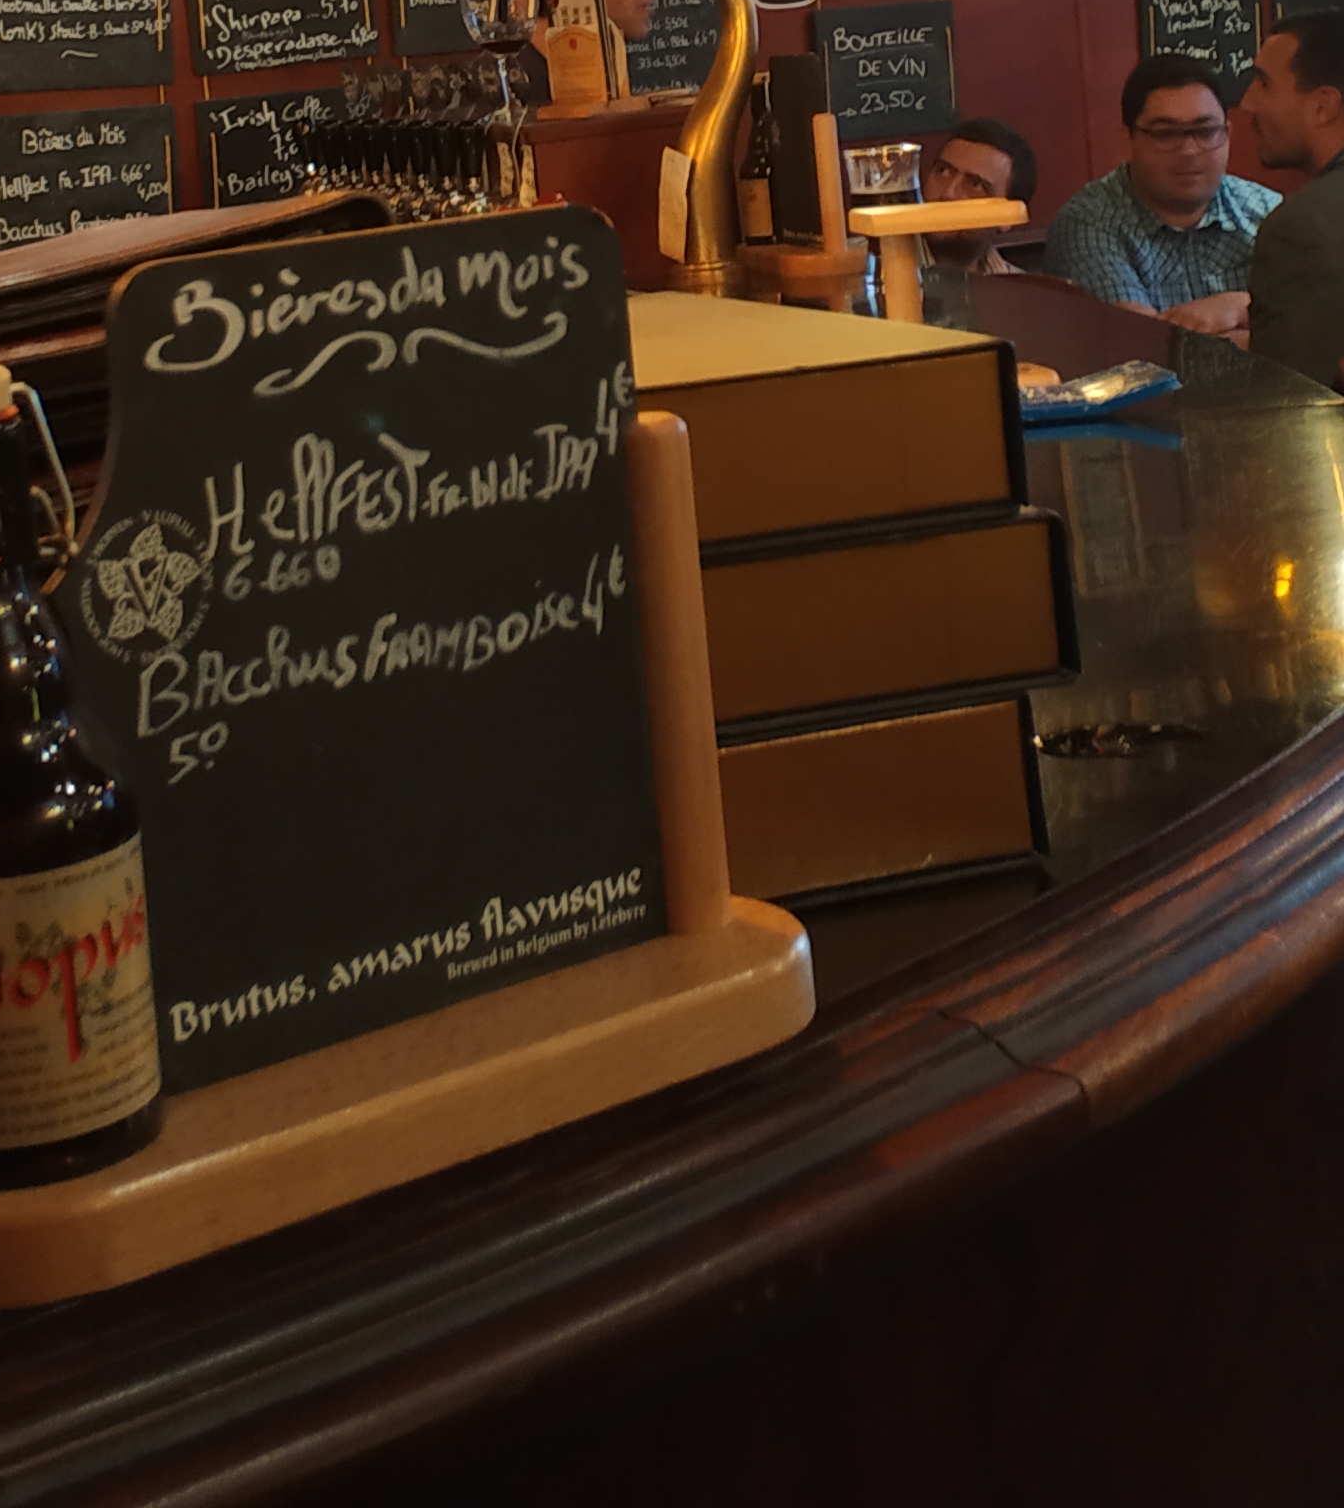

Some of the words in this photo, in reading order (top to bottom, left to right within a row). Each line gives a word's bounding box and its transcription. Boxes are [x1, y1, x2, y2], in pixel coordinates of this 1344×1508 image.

[833, 27, 933, 52] BOUTEILLE
[858, 59, 882, 77] DE
[887, 54, 925, 78] VIN
[219, 100, 280, 134] Irish
[860, 90, 926, 115] 23,50€
[21, 128, 74, 155] Bières
[76, 126, 94, 148] du
[227, 163, 305, 196] Bailey's
[169, 974, 317, 1043] Brutus,
[327, 915, 472, 995] amarus
[479, 866, 644, 942] flavusque
[447, 947, 497, 981] Brewed
[500, 946, 514, 963] in
[516, 928, 572, 955] Belgium
[573, 920, 589, 940] by
[592, 903, 647, 933] Lefebvre
